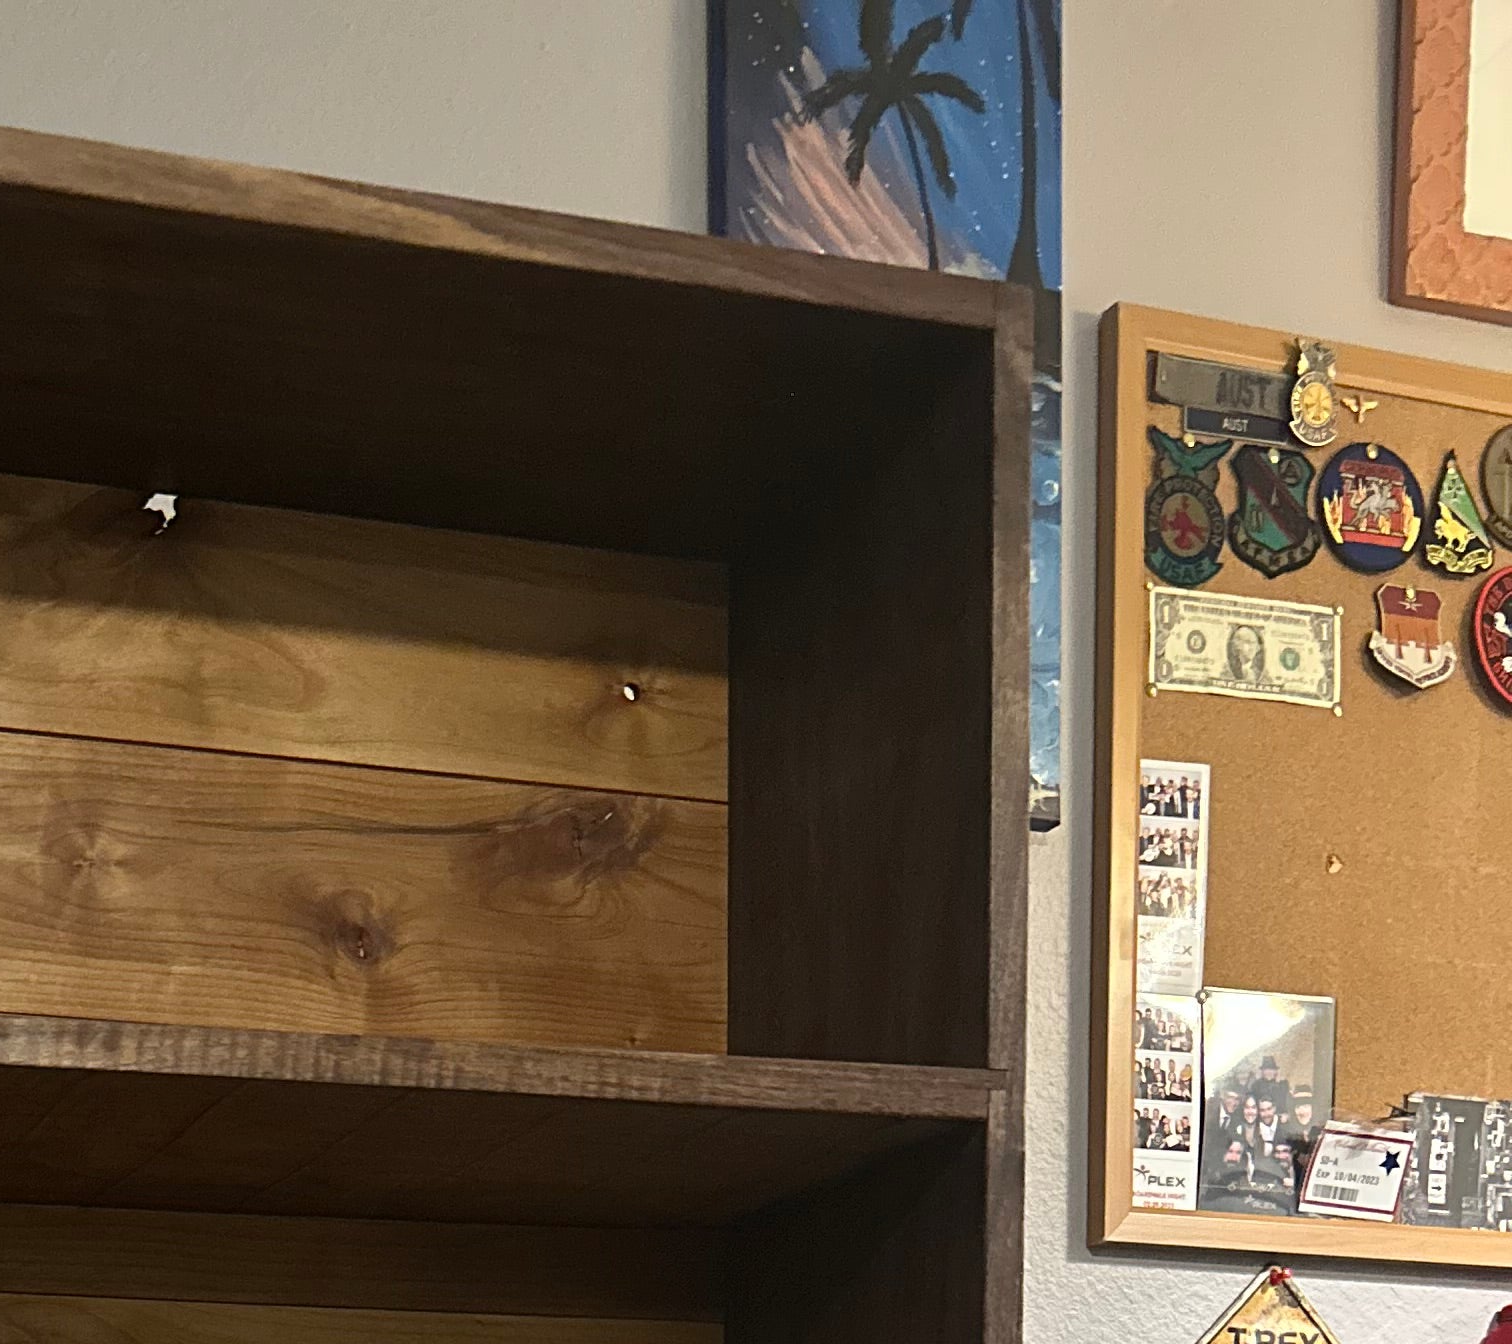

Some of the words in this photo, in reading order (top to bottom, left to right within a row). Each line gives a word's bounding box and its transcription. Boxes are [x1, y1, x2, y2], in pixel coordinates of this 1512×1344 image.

[1215, 371, 1271, 409] AUST
[1222, 417, 1249, 432] AUST
[1148, 1175, 1186, 1188] PLEX
[1334, 1171, 1380, 1186] 10/04/2023
